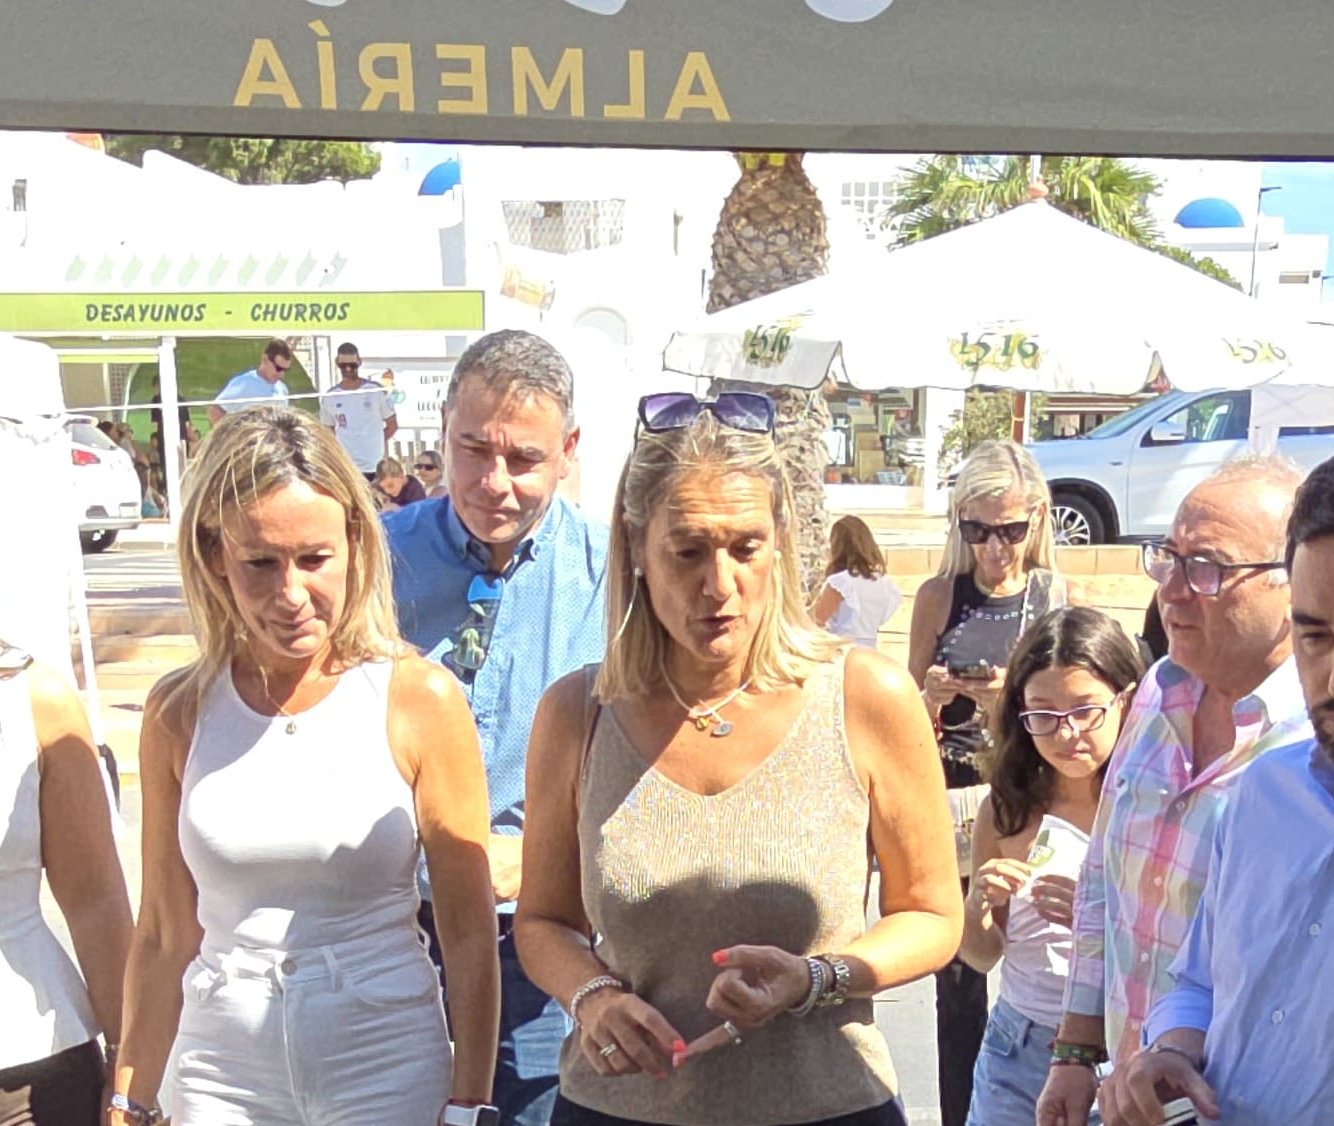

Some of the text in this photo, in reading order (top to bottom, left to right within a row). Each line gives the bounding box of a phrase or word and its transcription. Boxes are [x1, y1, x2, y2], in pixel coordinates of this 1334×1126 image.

[85, 303, 207, 323] DESAYUNOS
[250, 302, 351, 323] CHURROS
[958, 331, 1040, 368] 1516
